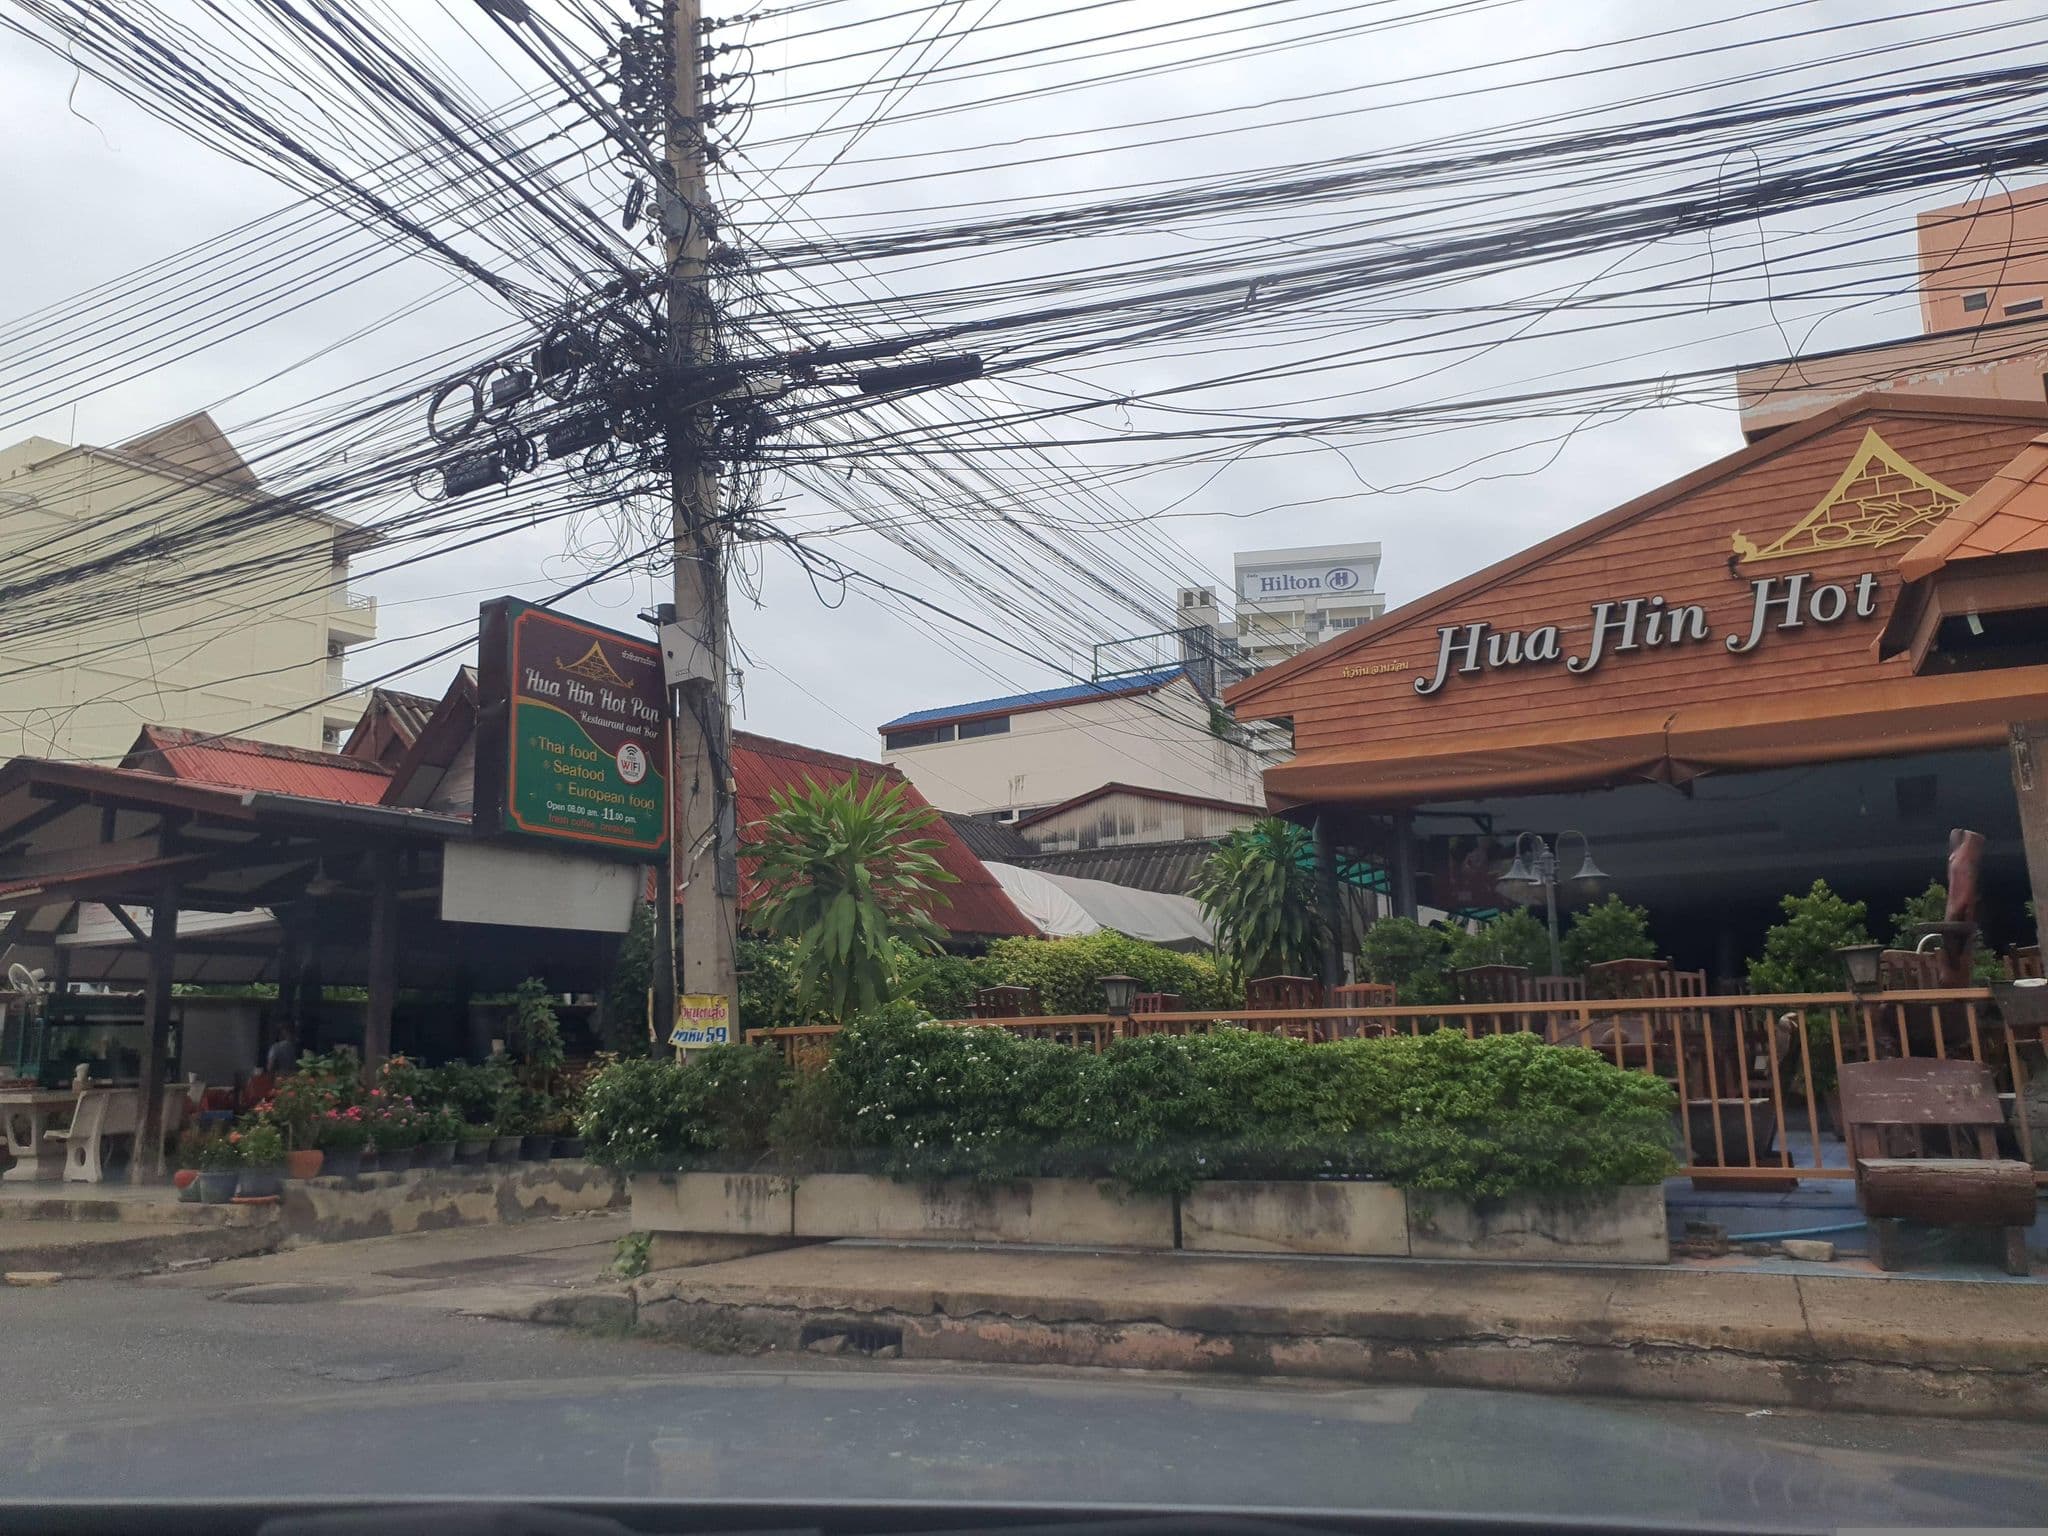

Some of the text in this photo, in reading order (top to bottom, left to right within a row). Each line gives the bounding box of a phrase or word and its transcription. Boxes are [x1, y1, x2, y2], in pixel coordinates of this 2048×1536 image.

[1261, 574, 1321, 592] Hilton
[1414, 573, 1877, 695] Hua Hin Hot
[526, 667, 660, 723] Hua Hin Hot Pan
[580, 710, 625, 731] Restaurant
[626, 725, 642, 735] and
[538, 736, 598, 761] Thai food
[553, 760, 605, 781] Seafood
[546, 800, 565, 811] Open
[568, 782, 655, 809] European food
[706, 1026, 727, 1044] 59
